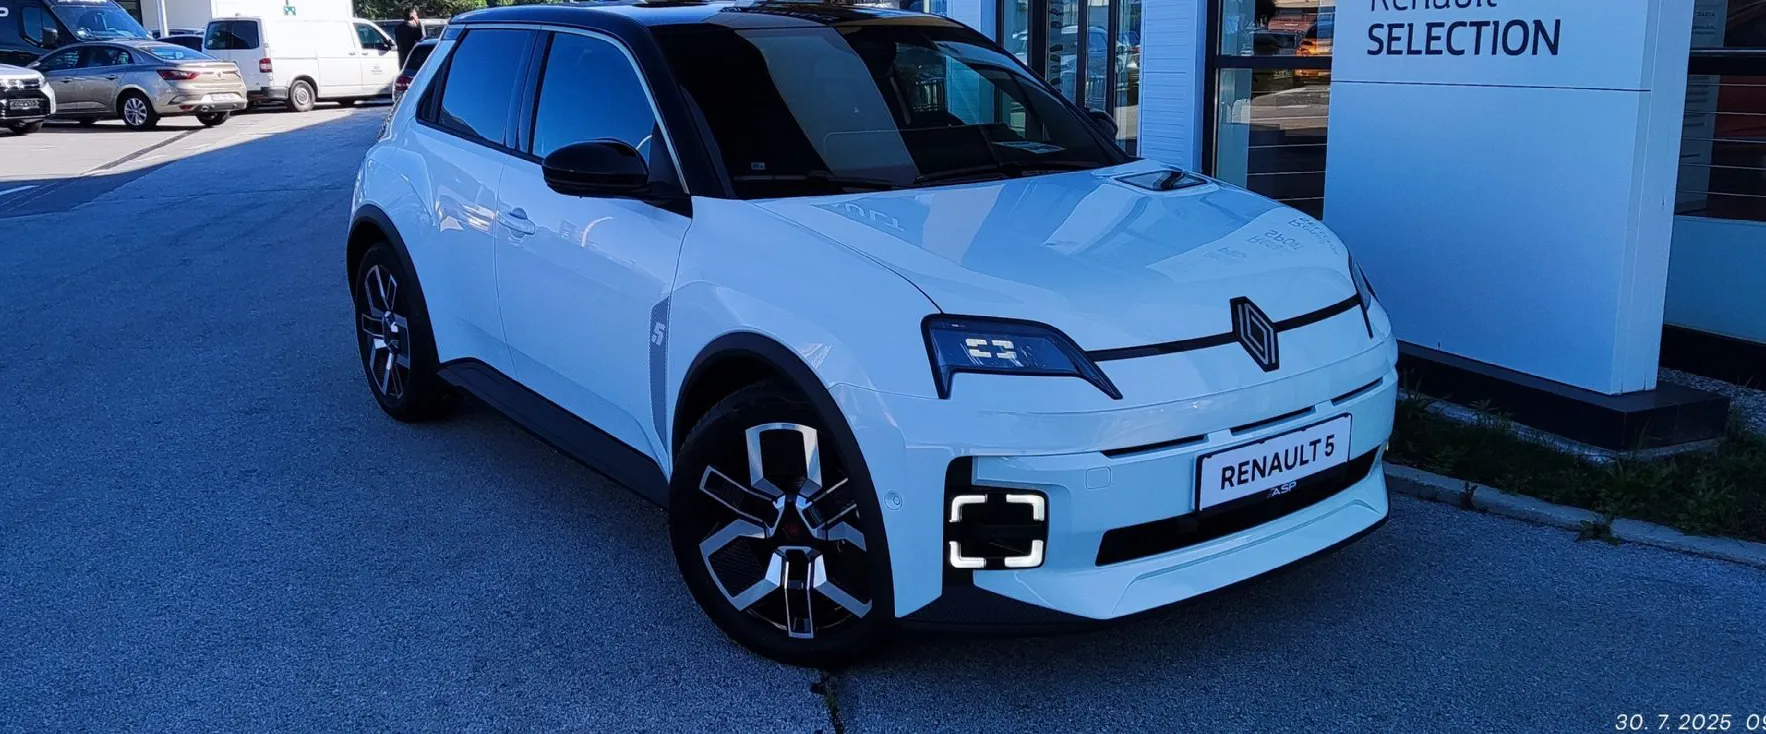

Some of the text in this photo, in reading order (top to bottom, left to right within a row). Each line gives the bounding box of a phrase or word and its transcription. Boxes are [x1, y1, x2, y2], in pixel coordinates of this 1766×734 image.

[1366, 19, 1562, 56] SELECTION
[651, 322, 666, 346] 5
[1220, 434, 1336, 490] RENAULT 5
[1270, 480, 1297, 497] ASP
